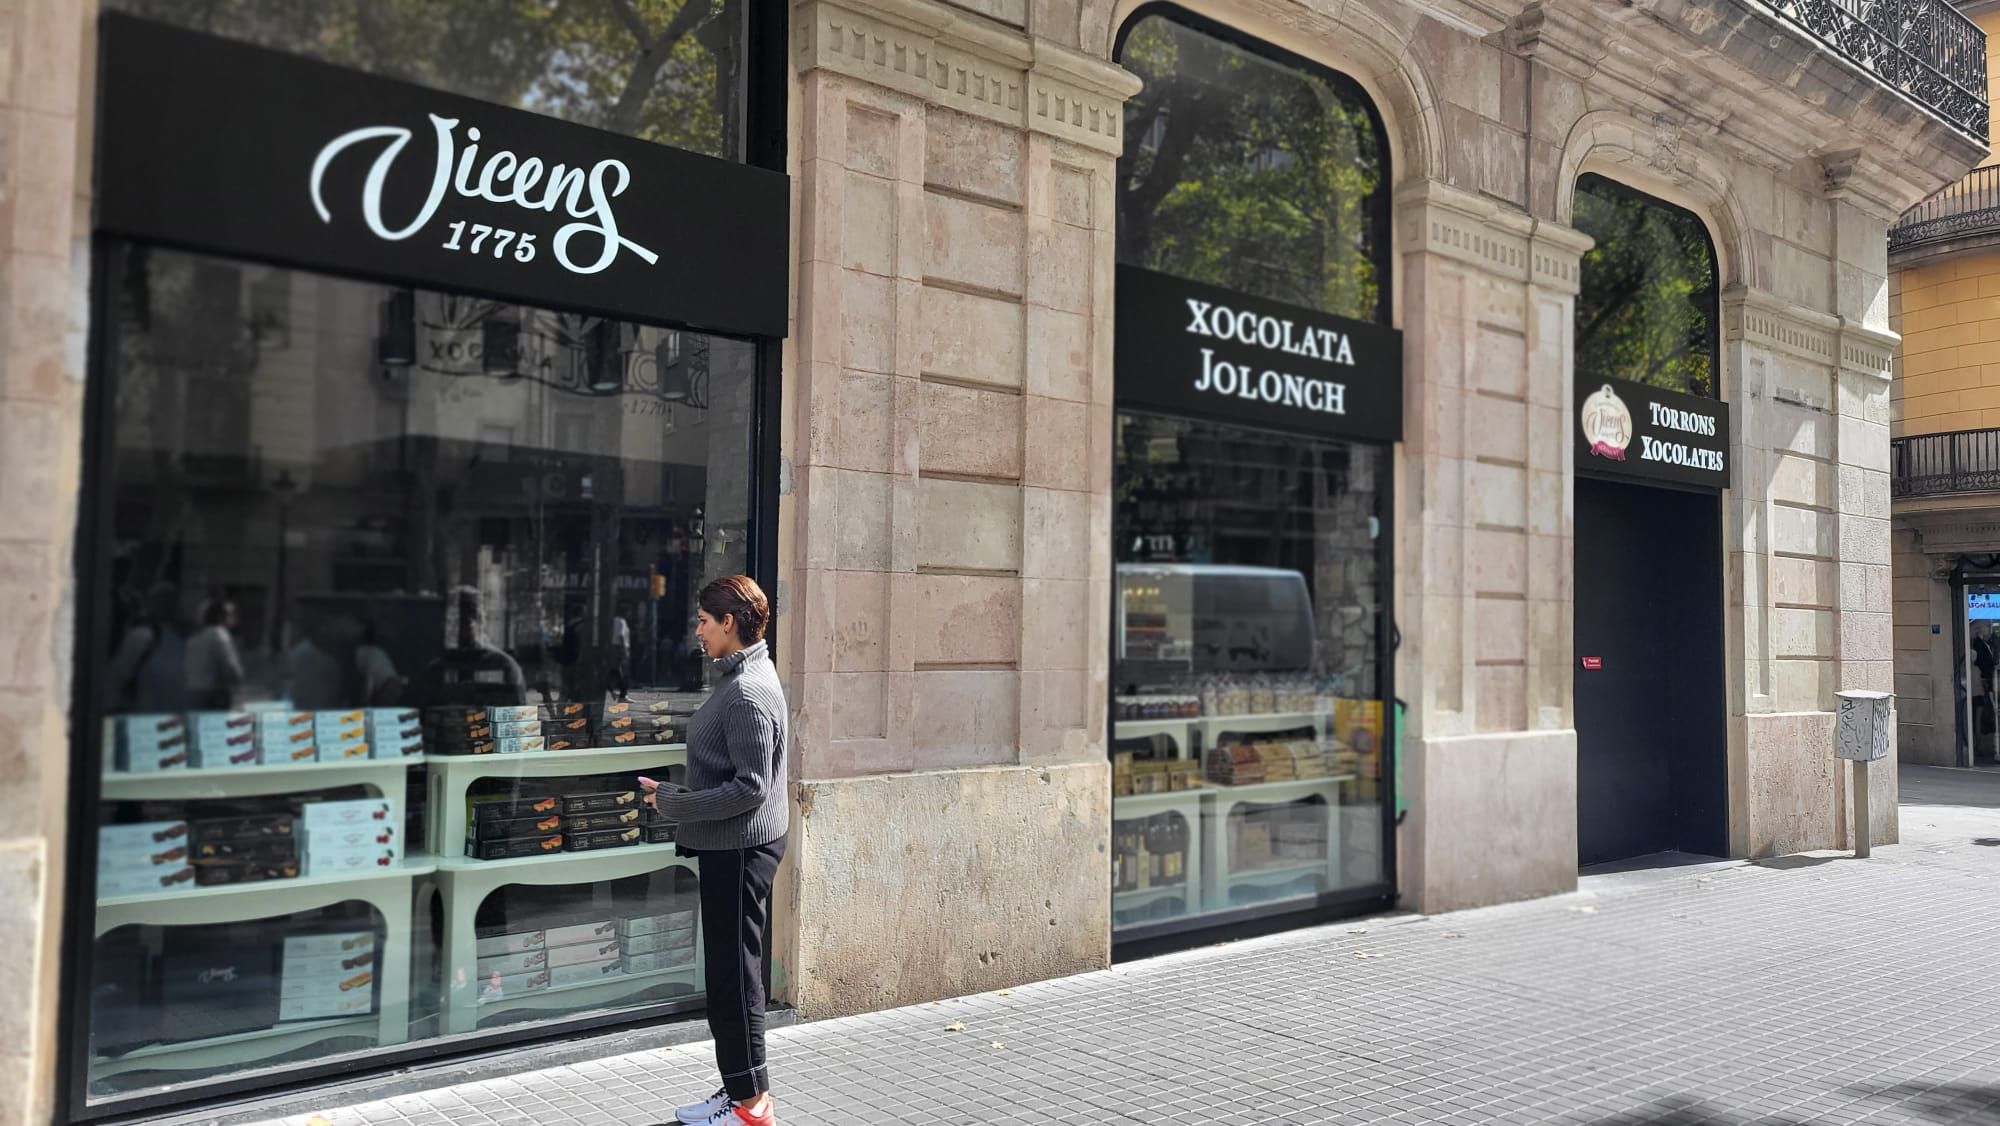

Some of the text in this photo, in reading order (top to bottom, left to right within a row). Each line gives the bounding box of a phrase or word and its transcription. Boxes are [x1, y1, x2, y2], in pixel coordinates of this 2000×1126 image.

[311, 114, 659, 275] Vicens
[443, 221, 537, 263] 1775
[1186, 298, 1355, 366] XOCOLATA
[1194, 348, 1346, 415] JOLONCH
[1649, 401, 1716, 437] TORRONS
[1640, 435, 1724, 472] XOCOLATES
